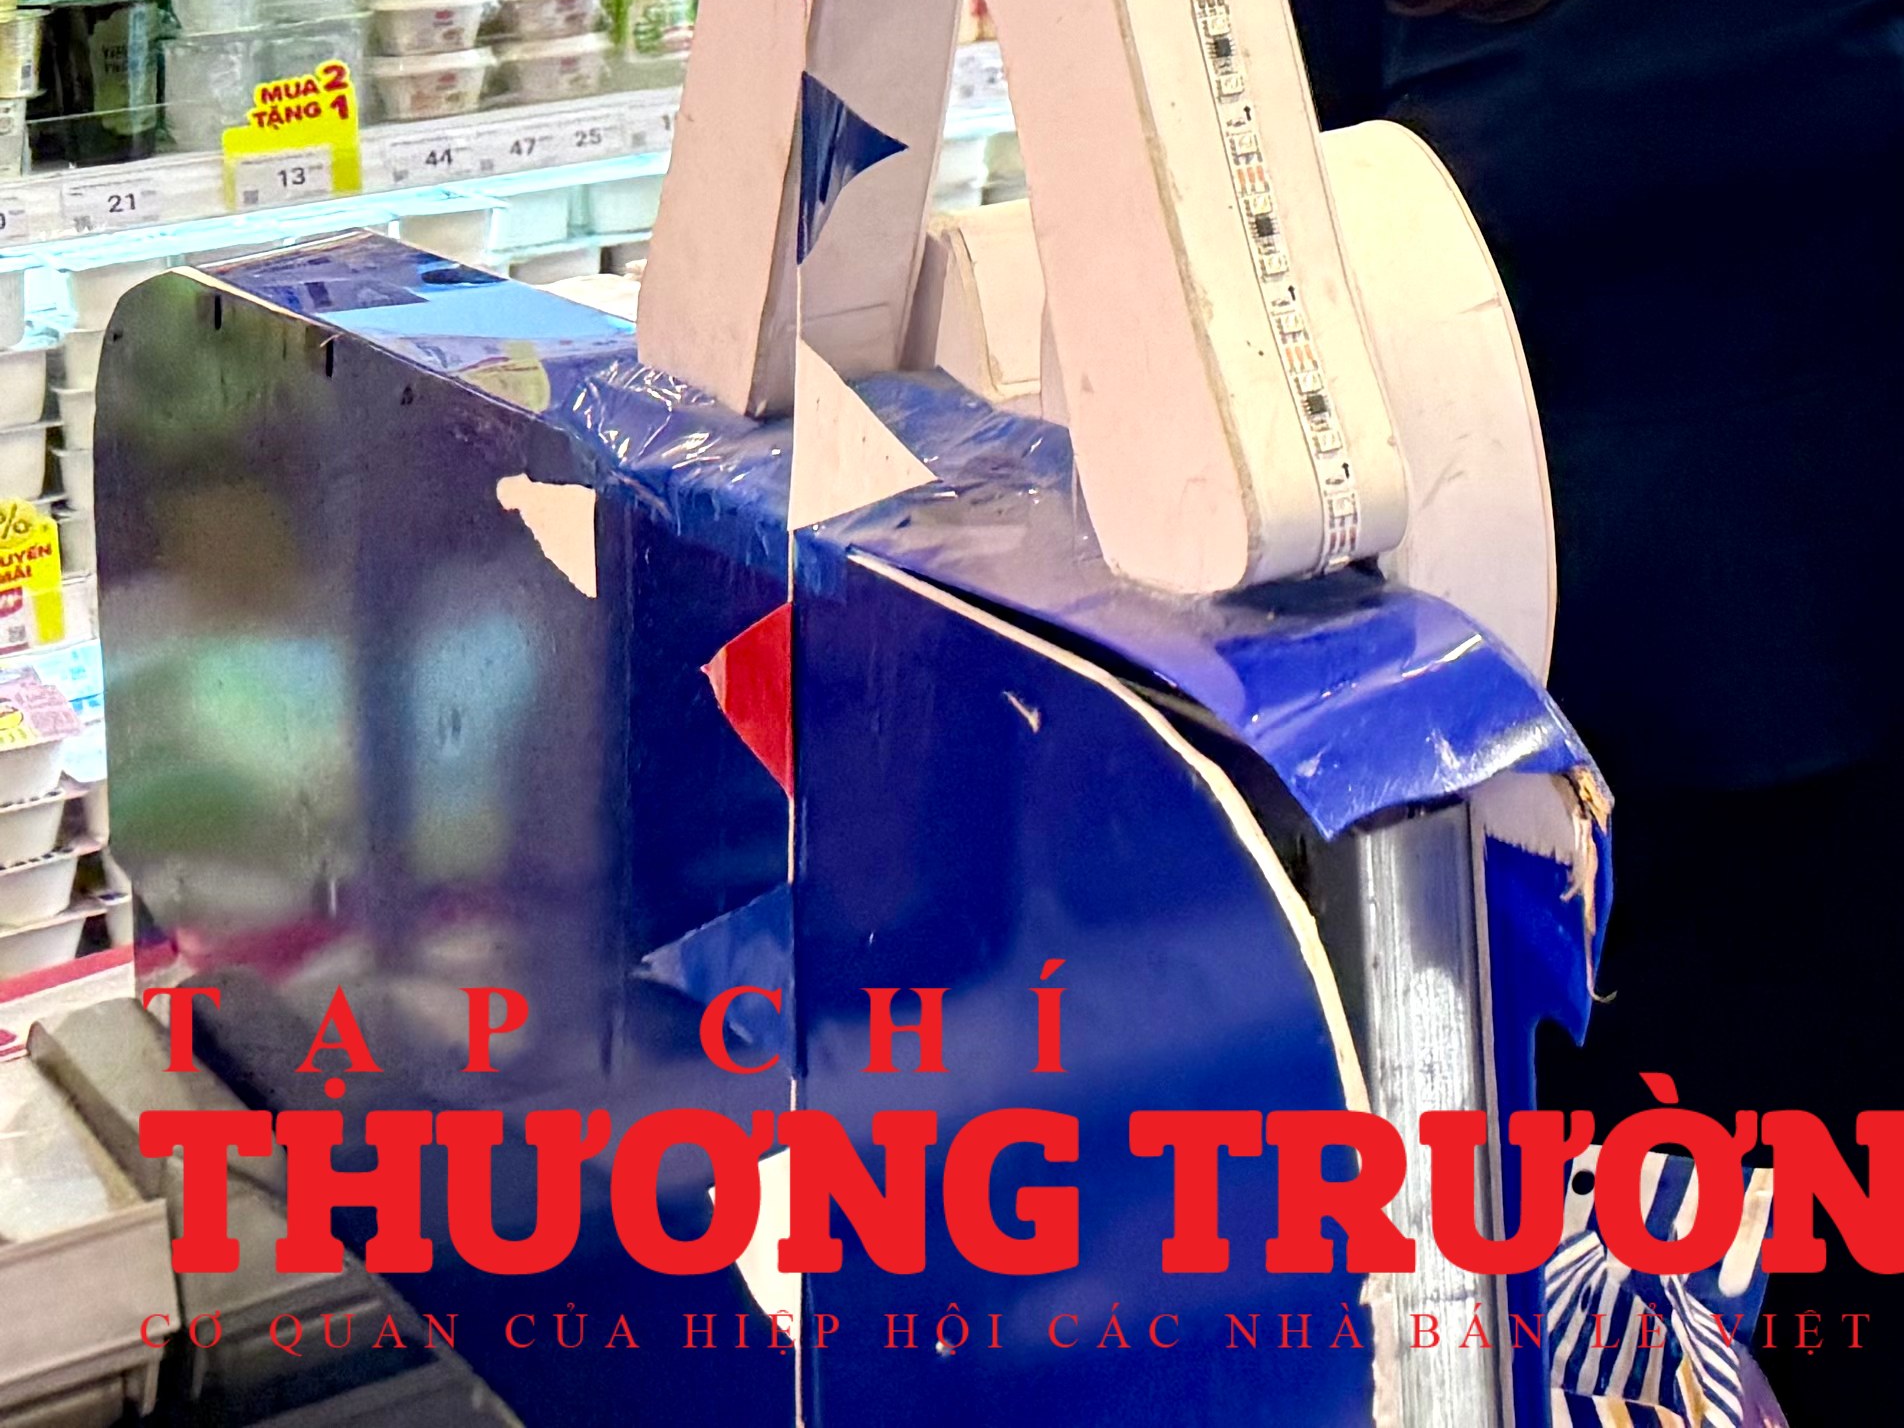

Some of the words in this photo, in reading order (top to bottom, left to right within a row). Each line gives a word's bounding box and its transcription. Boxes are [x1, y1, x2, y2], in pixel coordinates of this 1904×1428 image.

[259, 77, 318, 105] MUA
[322, 64, 349, 91] 2
[252, 101, 323, 130] TẶNG
[330, 94, 349, 121] 1
[574, 127, 602, 147] 25
[425, 148, 455, 168] 44
[509, 138, 537, 158] 47
[277, 166, 307, 188] 13
[107, 193, 137, 214] 21
[0, 544, 53, 569] UYẾN
